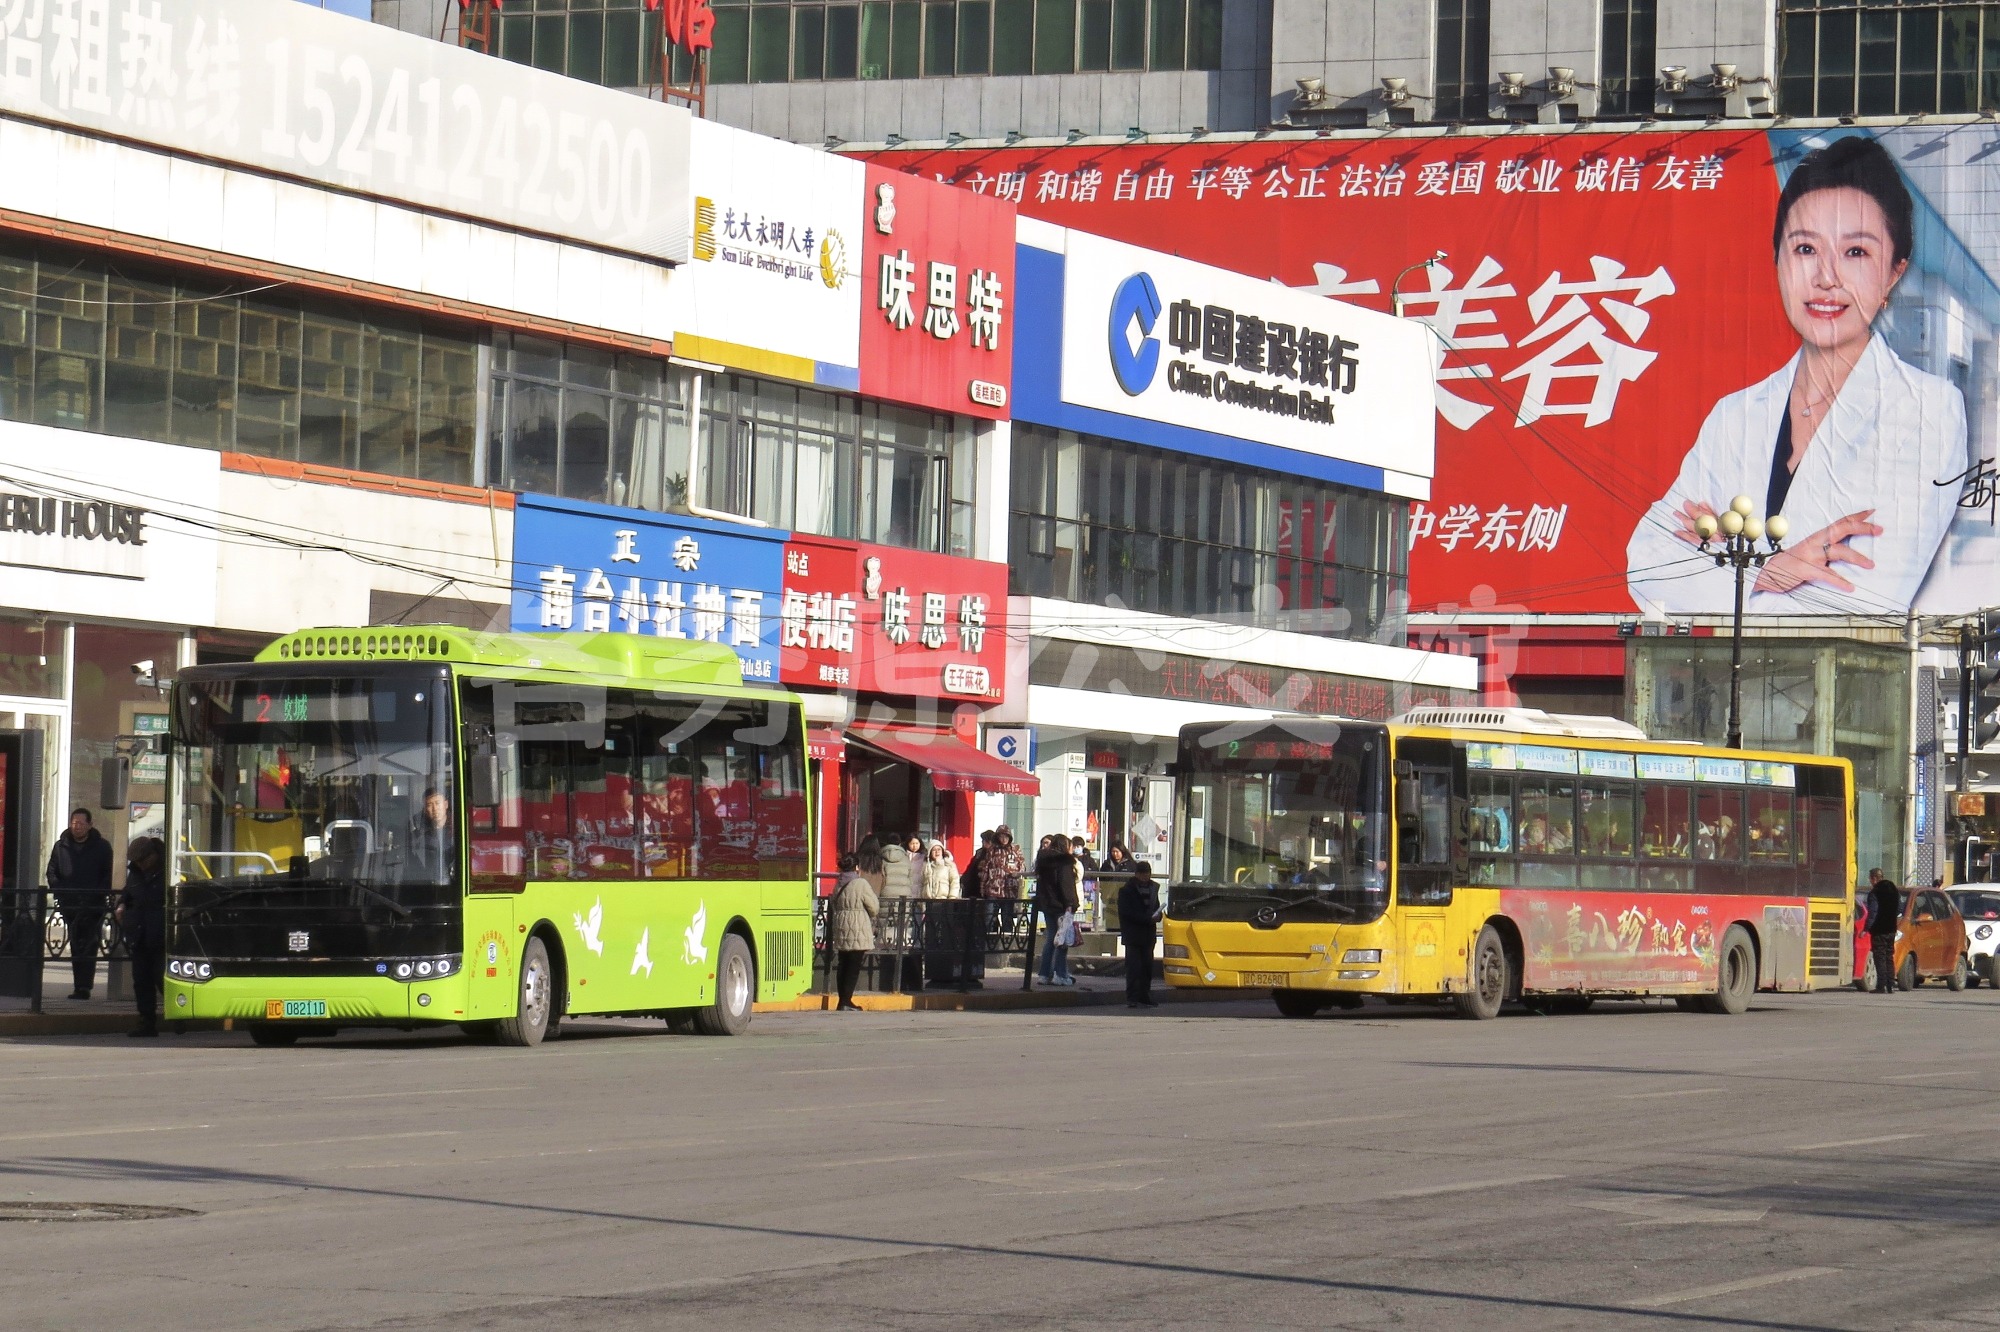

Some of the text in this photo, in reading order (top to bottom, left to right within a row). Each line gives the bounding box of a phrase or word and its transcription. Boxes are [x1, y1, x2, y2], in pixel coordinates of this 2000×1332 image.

[261, 36, 652, 232] 15241242500
[966, 154, 1725, 204] 文明 和谐 自由 平等 公正 法治 爱国 敬业 诚信 友善
[723, 207, 814, 259] 光大永明人寿
[722, 247, 737, 263] Sun
[739, 251, 753, 267] Life
[799, 265, 813, 281] Life
[878, 249, 1004, 351] 味思特
[1168, 299, 1360, 394] 中国建设银行
[1270, 255, 1676, 431] 美容
[1168, 360, 1335, 426] China Construction Bank
[61, 499, 148, 547] HOUSE
[611, 529, 700, 572] 正宗
[787, 550, 809, 577] 站点
[781, 588, 857, 653] 便利店
[882, 586, 987, 655] 味思特
[819, 664, 849, 685] 烟草专卖
[949, 668, 984, 691] 王子麻花
[256, 693, 271, 722] 2
[1228, 741, 1239, 758] 2
[286, 1002, 326, 1016] 08211D
